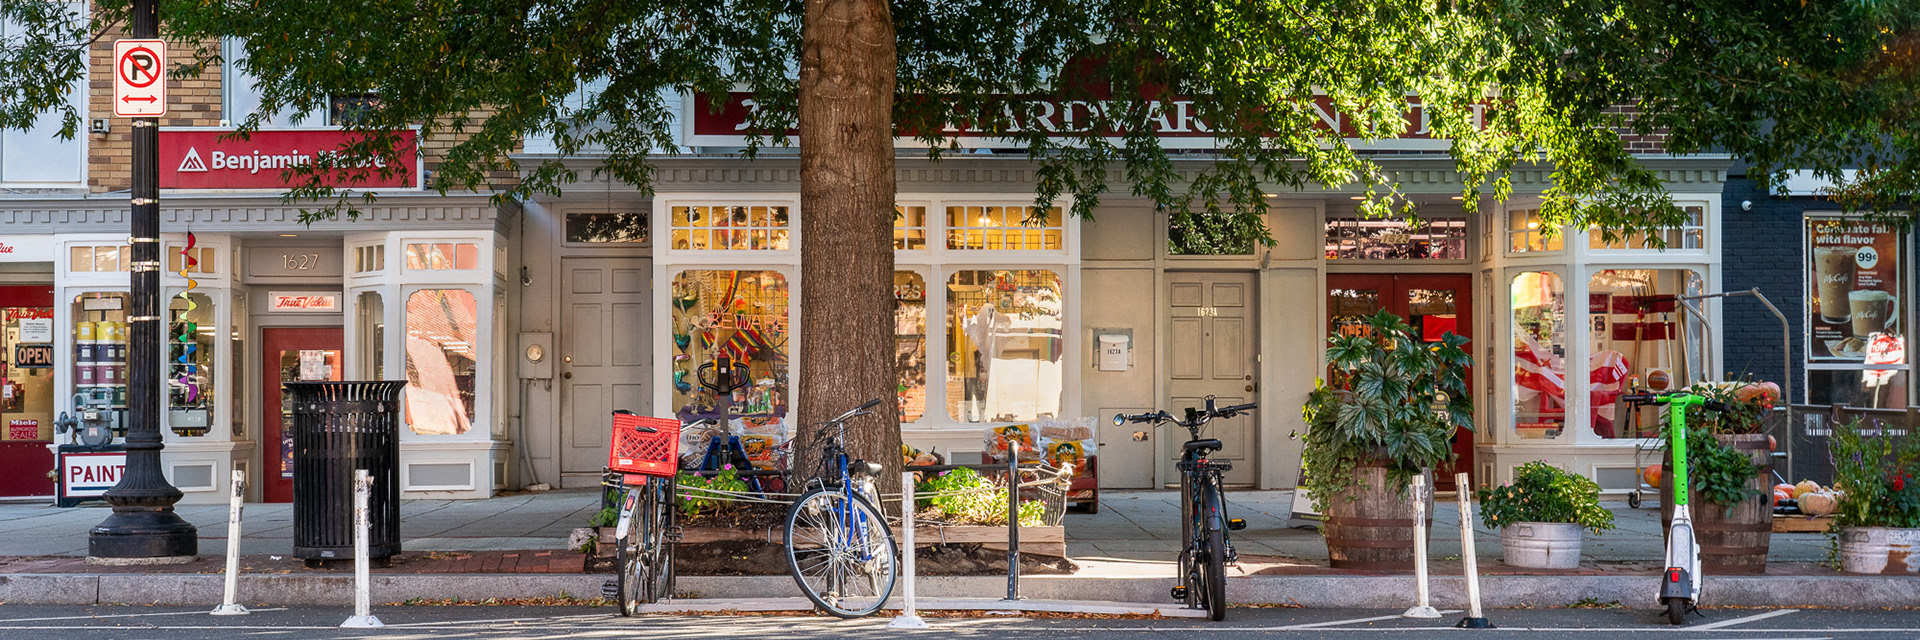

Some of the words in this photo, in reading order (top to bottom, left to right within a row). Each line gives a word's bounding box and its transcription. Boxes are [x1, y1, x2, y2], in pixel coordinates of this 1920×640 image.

[942, 100, 1236, 133] HARDWAR
[211, 149, 312, 174] Benjamin
[1816, 223, 1870, 234] Cerate
[1816, 234, 1841, 244] with
[1843, 234, 1875, 244] flavor
[282, 254, 320, 270] 1627
[276, 296, 302, 308] True
[297, 296, 333, 309] Value
[6, 308, 31, 320] True
[708, 312, 789, 333] BEWARE
[1339, 325, 1372, 340] OPEN
[18, 347, 51, 365] OPEN
[70, 465, 126, 482] PAINT
